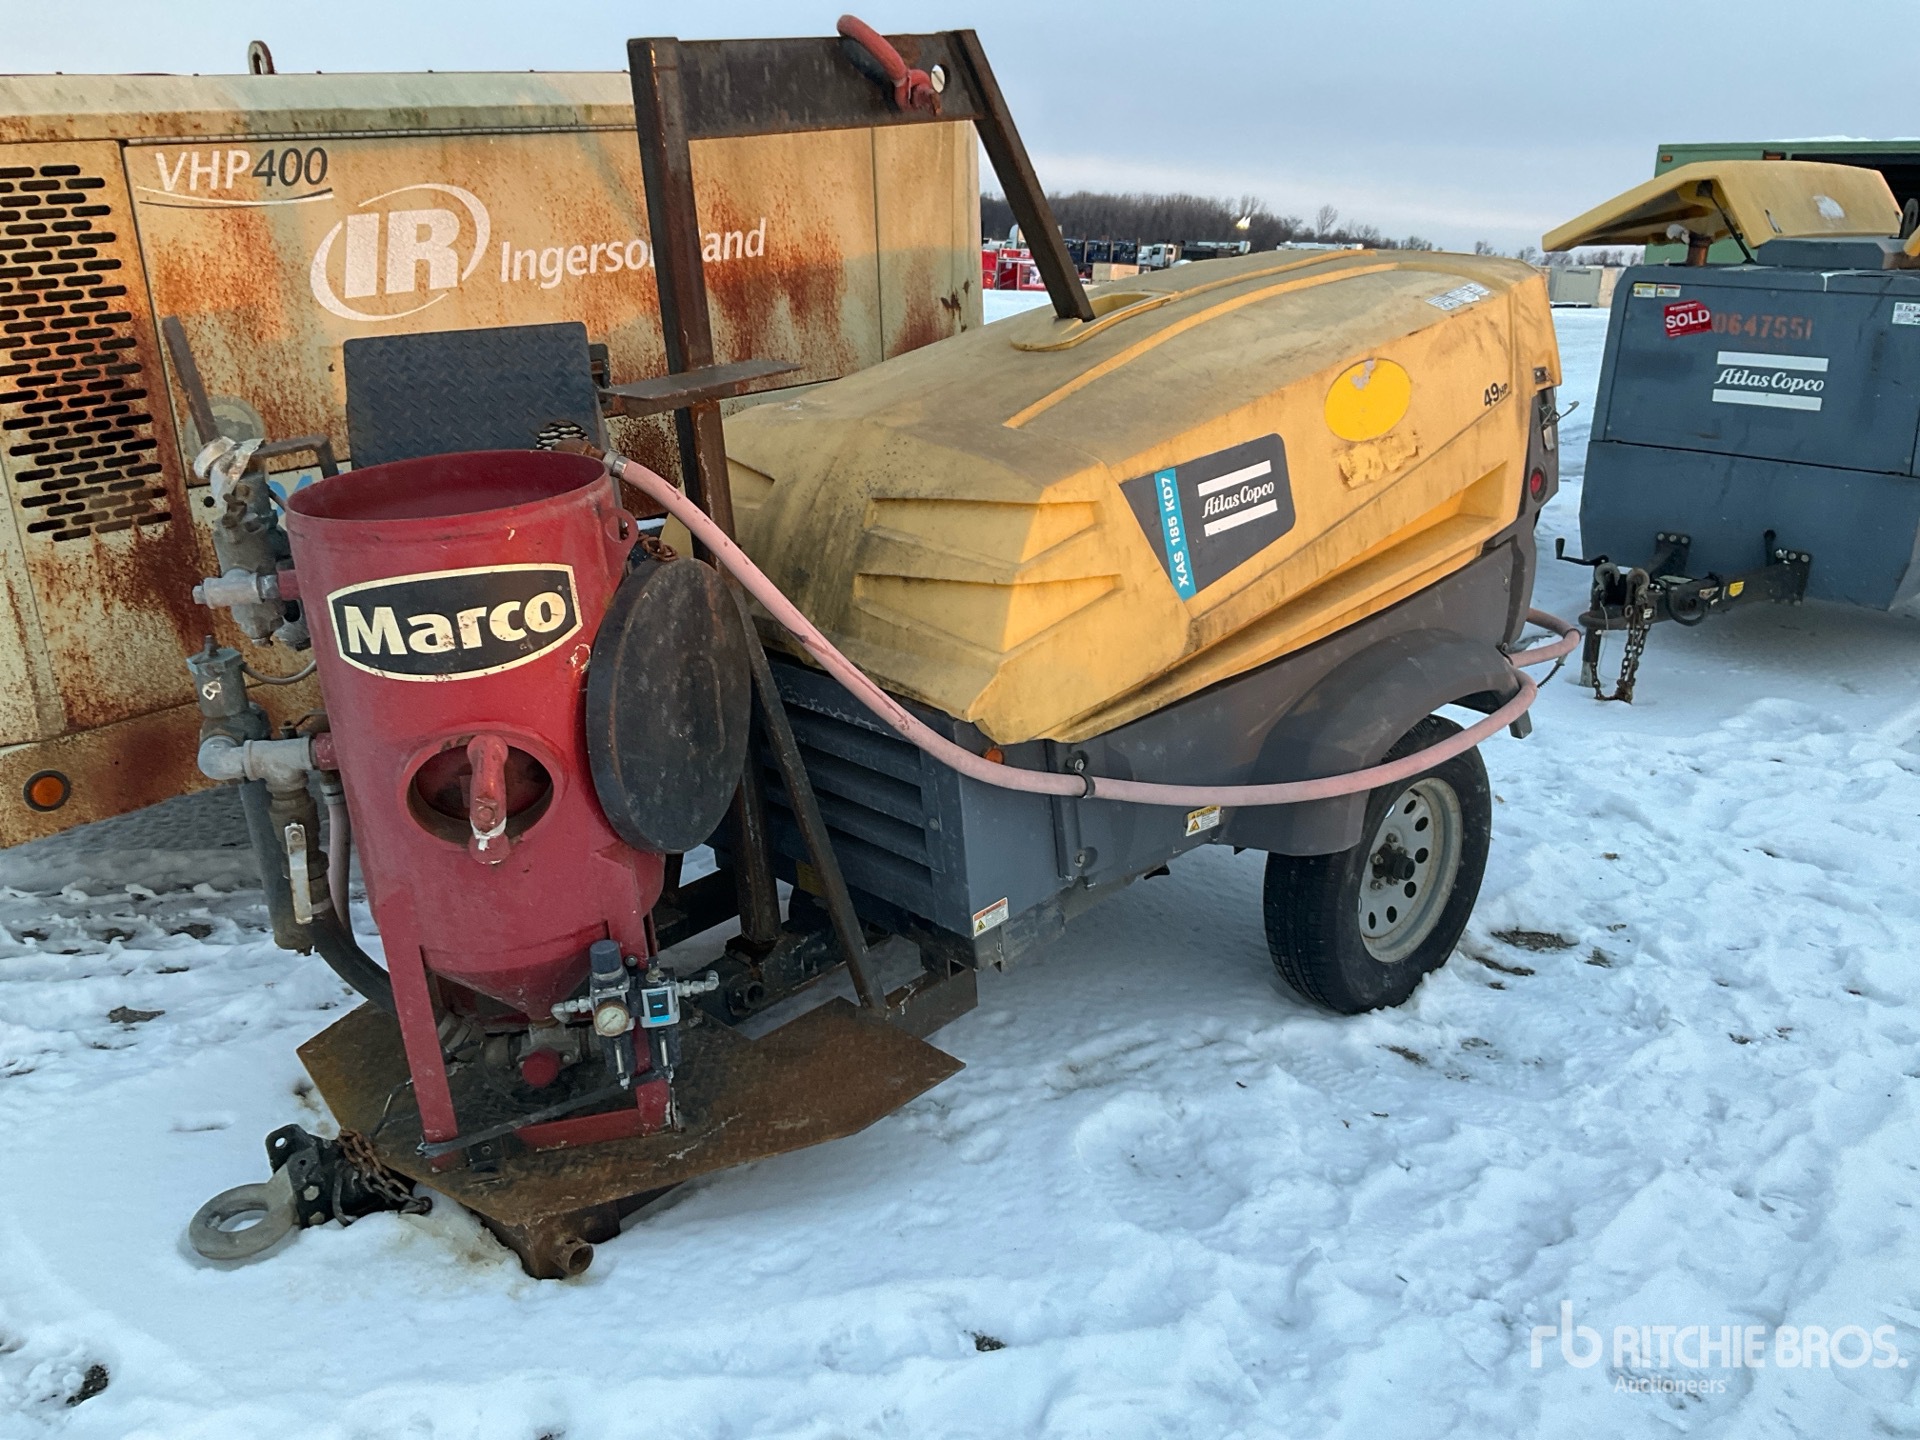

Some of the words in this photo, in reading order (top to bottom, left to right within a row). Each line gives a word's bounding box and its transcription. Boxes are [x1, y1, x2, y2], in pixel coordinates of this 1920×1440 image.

[344, 208, 461, 299] IR
[699, 217, 767, 264] and
[1665, 309, 1710, 329] SOLD
[1714, 368, 1770, 387] Atlas
[1771, 372, 1825, 392] Copco
[1161, 477, 1175, 512] KD7
[1201, 494, 1240, 519] Atlas
[1240, 481, 1275, 504] Copco
[1167, 516, 1181, 546] 185
[1173, 551, 1190, 588] XAS
[344, 592, 567, 655] Marco
